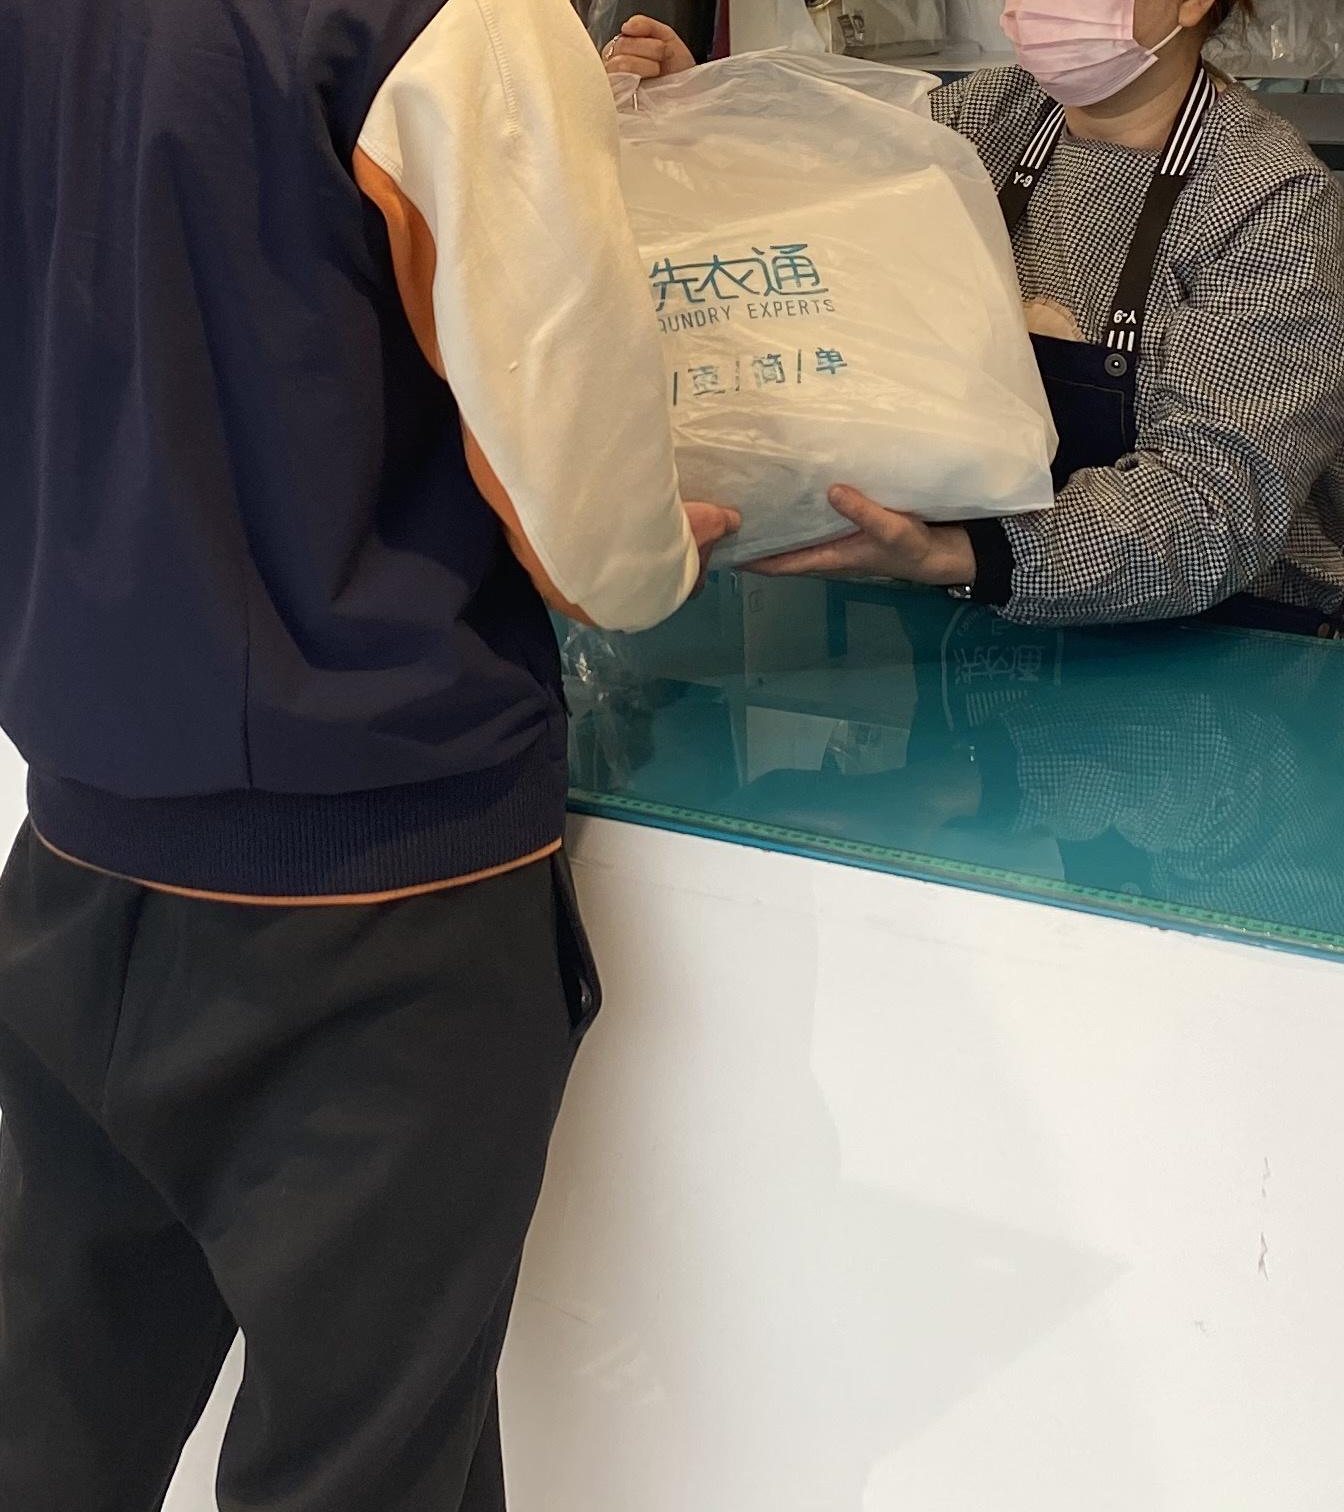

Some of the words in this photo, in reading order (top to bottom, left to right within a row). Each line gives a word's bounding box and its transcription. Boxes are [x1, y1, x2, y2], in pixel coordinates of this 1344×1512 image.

[1013, 171, 1034, 188] Y-9
[658, 305, 732, 334] AUNDRY
[747, 299, 836, 320] EXPERTS
